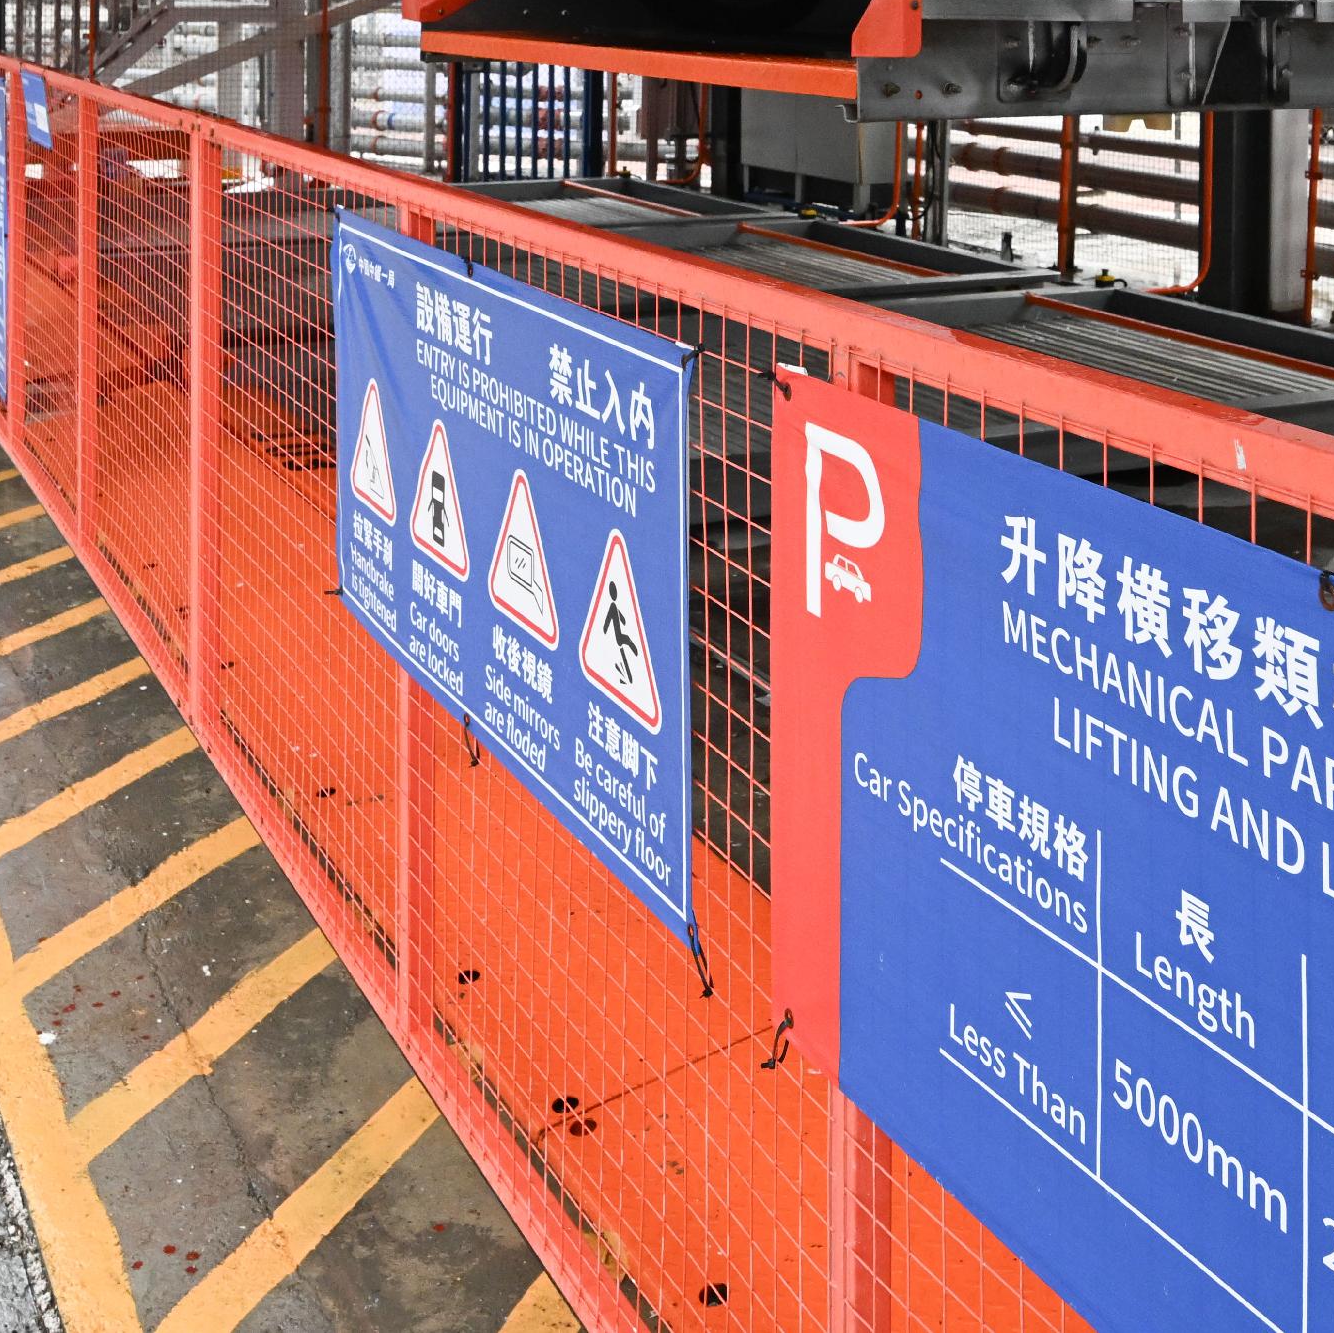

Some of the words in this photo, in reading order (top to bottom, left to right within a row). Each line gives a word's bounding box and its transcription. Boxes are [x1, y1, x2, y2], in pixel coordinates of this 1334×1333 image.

[416, 281, 493, 366] 設備運行
[416, 339, 455, 381] ENTRY
[458, 362, 469, 389] IS
[472, 367, 556, 436] PROHIBITED
[560, 414, 610, 468] WHILE
[613, 443, 656, 493] THIS
[431, 374, 504, 439] EQUIPMENT
[508, 418, 522, 448] IS
[524, 427, 539, 460] IN
[542, 438, 637, 518] OPERATION
[350, 542, 394, 602] Handbrake
[804, 421, 886, 618] P
[360, 577, 397, 634] tightened
[409, 601, 428, 634] Car
[429, 617, 460, 663] doors
[412, 559, 462, 629] 關好車門
[409, 634, 427, 663] are
[428, 643, 464, 697] locked
[485, 664, 512, 708] Side
[514, 690, 561, 752] mirrors
[492, 623, 553, 705] 收後視鏡
[1002, 601, 1249, 766] MECHANICAL
[484, 700, 504, 734] are
[506, 711, 546, 773] floded
[575, 737, 593, 777] Be
[595, 762, 647, 828] careful
[649, 811, 667, 844] of
[1053, 697, 1199, 818] LIFTING
[1210, 786, 1305, 875] AND
[573, 777, 632, 855] slippery
[635, 827, 672, 887] floor
[854, 752, 892, 802] Car
[897, 778, 1088, 934] Specifications
[953, 755, 1089, 882] 停車規格
[1175, 889, 1215, 963] 長
[1135, 931, 1255, 1048] Length
[949, 1003, 1007, 1079] Less
[1012, 1050, 1088, 1144] Than
[1112, 1068, 1289, 1235] 5000mm
